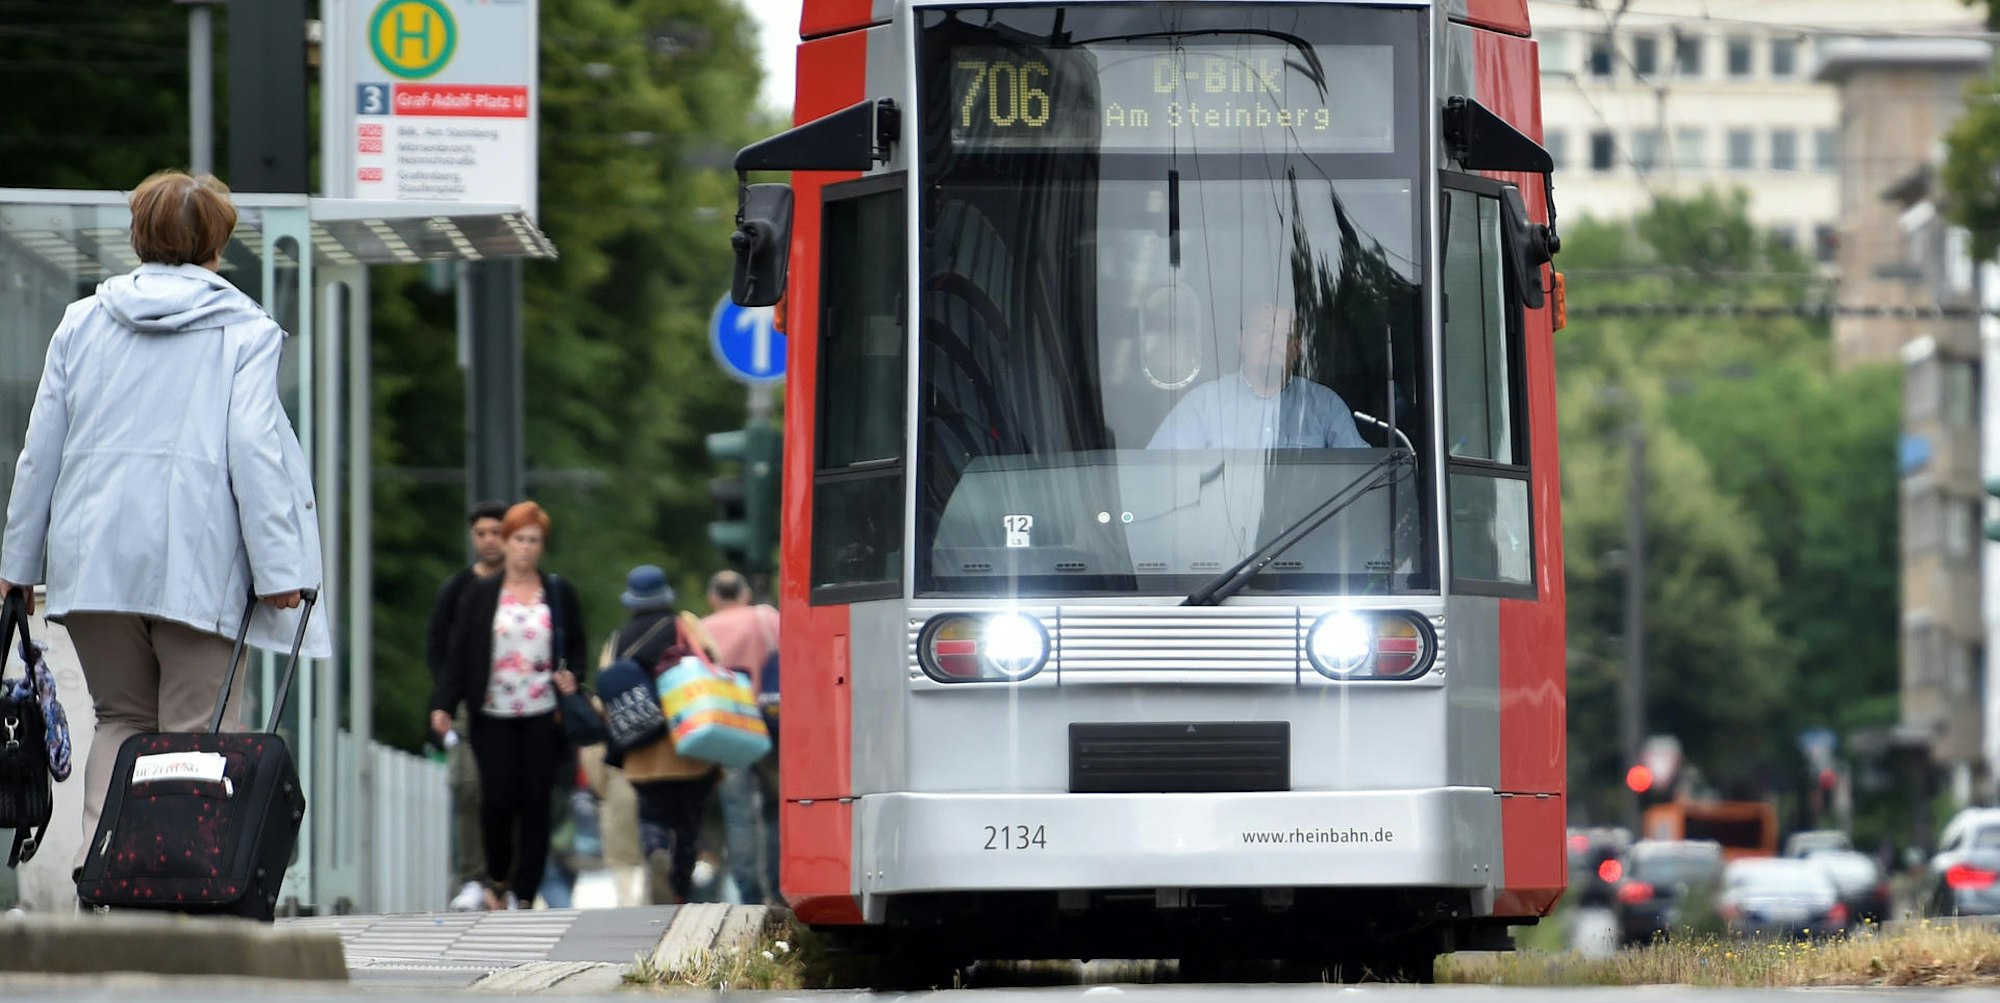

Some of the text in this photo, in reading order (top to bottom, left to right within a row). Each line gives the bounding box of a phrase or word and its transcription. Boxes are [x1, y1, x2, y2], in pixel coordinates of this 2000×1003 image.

[396, 12, 431, 59] H
[1153, 58, 1281, 93] D-Bilk
[363, 86, 382, 114] 3
[398, 91, 526, 109] Graf-Adolf-Platz U
[958, 62, 1049, 126] 706
[1106, 102, 1330, 130] Am Steinberg
[1006, 516, 1028, 532] 12
[984, 825, 1047, 850] 2134
[1242, 827, 1394, 843] www.rheinbahn.de
